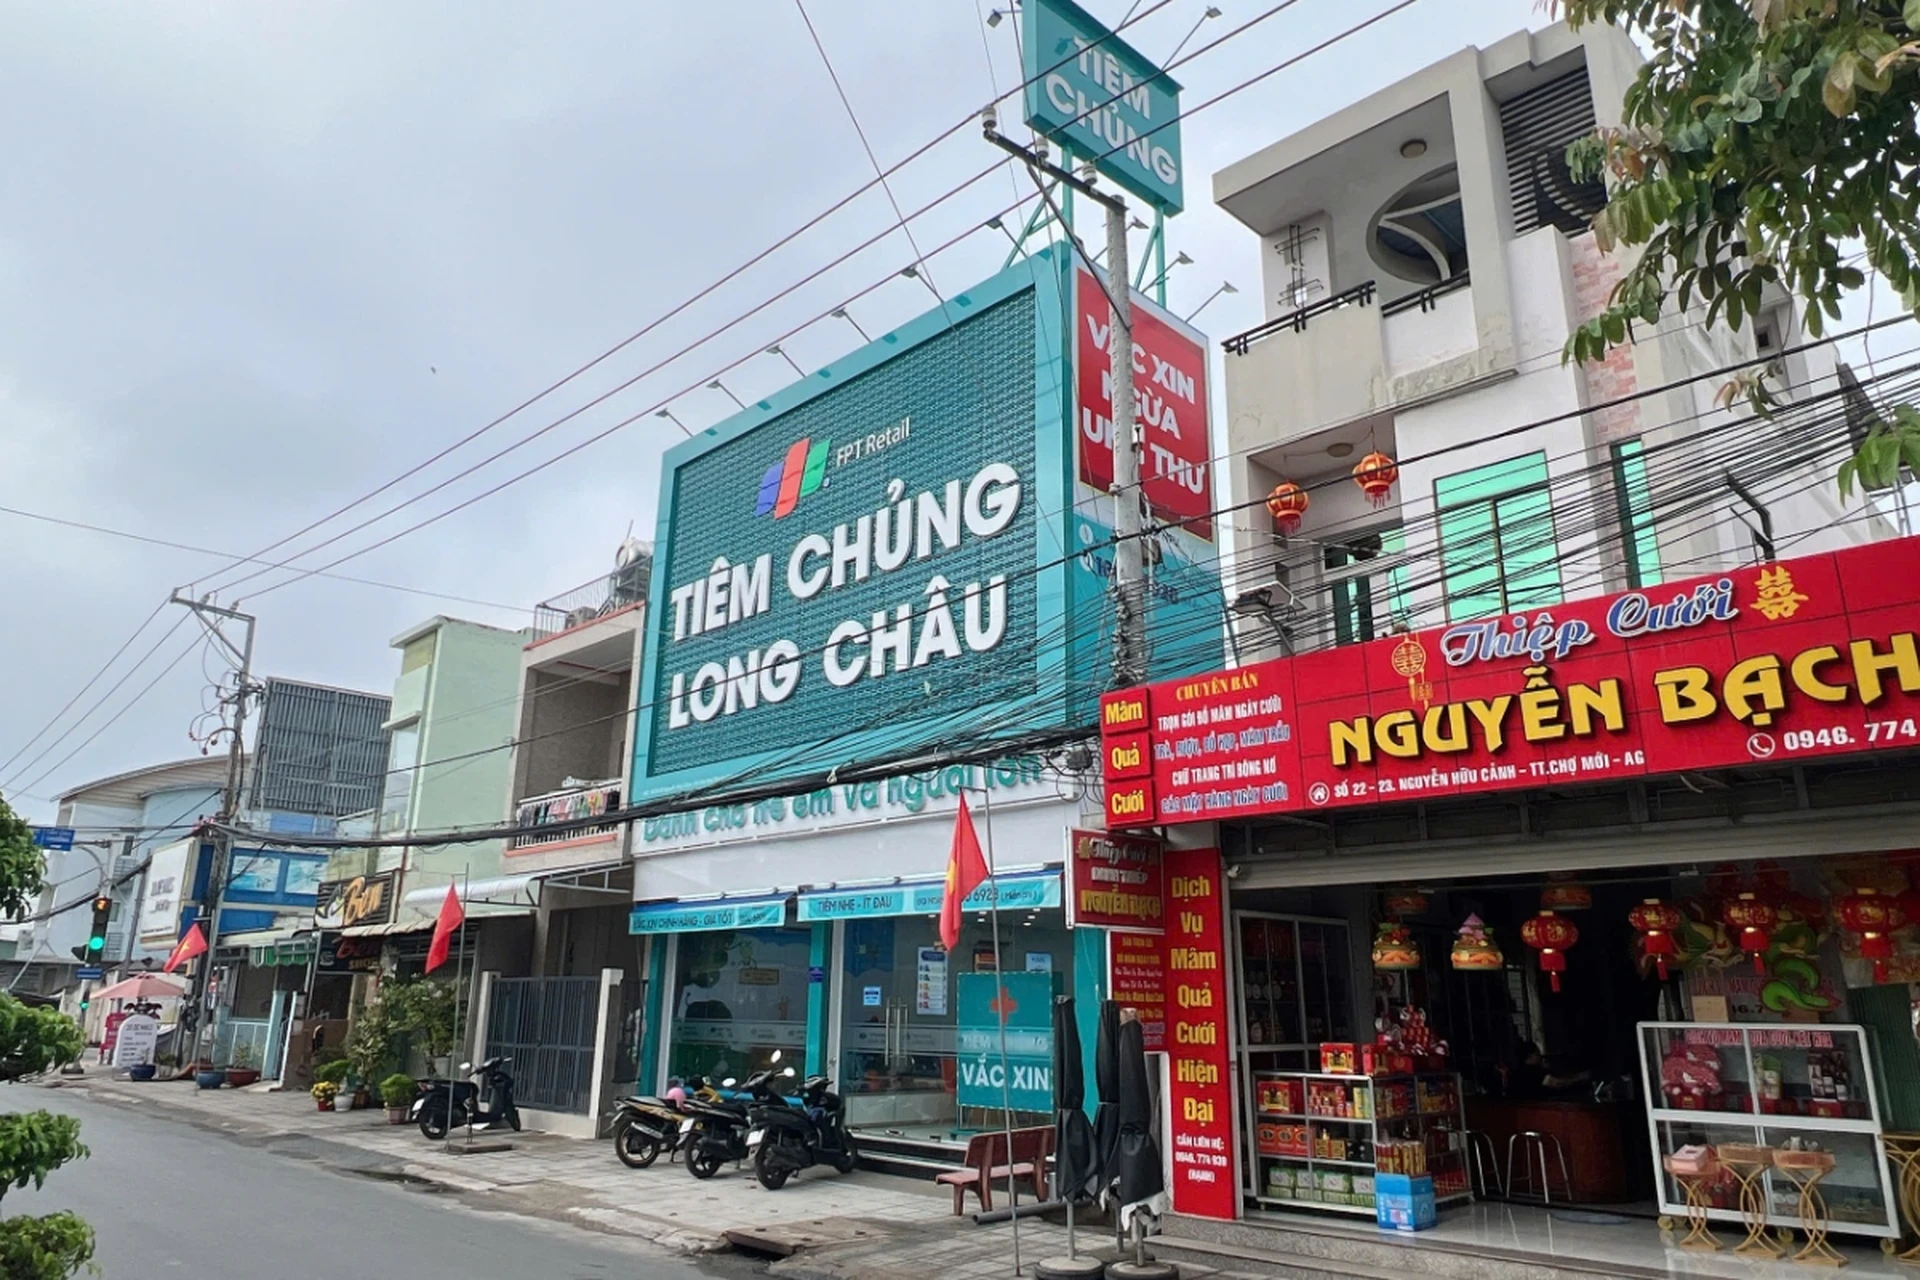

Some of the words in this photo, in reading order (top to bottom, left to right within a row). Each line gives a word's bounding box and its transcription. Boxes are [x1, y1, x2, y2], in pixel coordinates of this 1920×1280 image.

[1072, 34, 1150, 120] TIÊM
[1045, 73, 1177, 186] CHỦNG
[1086, 313, 1146, 374] VC
[1151, 352, 1195, 404] XIN
[836, 440, 862, 468] FPT
[865, 417, 911, 456] Retail
[1150, 442, 1205, 494] THƯ
[786, 462, 1021, 599] CHỦNG
[671, 555, 772, 642] TIÊM
[823, 574, 1006, 687] CHÂU
[1441, 612, 1596, 666] Thiệp
[1606, 577, 1739, 638] Cưới
[668, 639, 800, 730] LONG
[1176, 677, 1229, 701] CHUYÊN
[1231, 670, 1259, 691] BÁN
[1328, 664, 1625, 767] NGUYỄN
[1654, 631, 1920, 726] BẠCH
[1105, 700, 1142, 725] Mâm
[1158, 714, 1180, 733] TRỌN
[1181, 709, 1196, 728] GÓI
[1864, 718, 1917, 741] 774
[1111, 743, 1140, 770] Quả
[1191, 764, 1220, 784] TRANG
[1221, 760, 1236, 780] TRÍ
[1334, 779, 1349, 798] SỐ
[1352, 782, 1367, 796] 22
[1398, 764, 1448, 791] NGUYỄN
[1451, 765, 1478, 786] HỮU
[1481, 760, 1516, 783] CẢNH
[1581, 750, 1610, 771] MỚI
[1624, 749, 1645, 765] AG
[1111, 790, 1145, 815] Cưới
[1172, 876, 1211, 902] Dịch
[1180, 911, 1204, 938] Vụ
[1170, 946, 1216, 970] Mâm
[1177, 982, 1212, 1009] Quả
[1176, 1021, 1216, 1045] Cưới
[961, 1053, 1006, 1087] VẮC
[1012, 1065, 1050, 1091] XIN
[1177, 1058, 1218, 1088] Hiện
[1183, 1096, 1214, 1126] Đại
